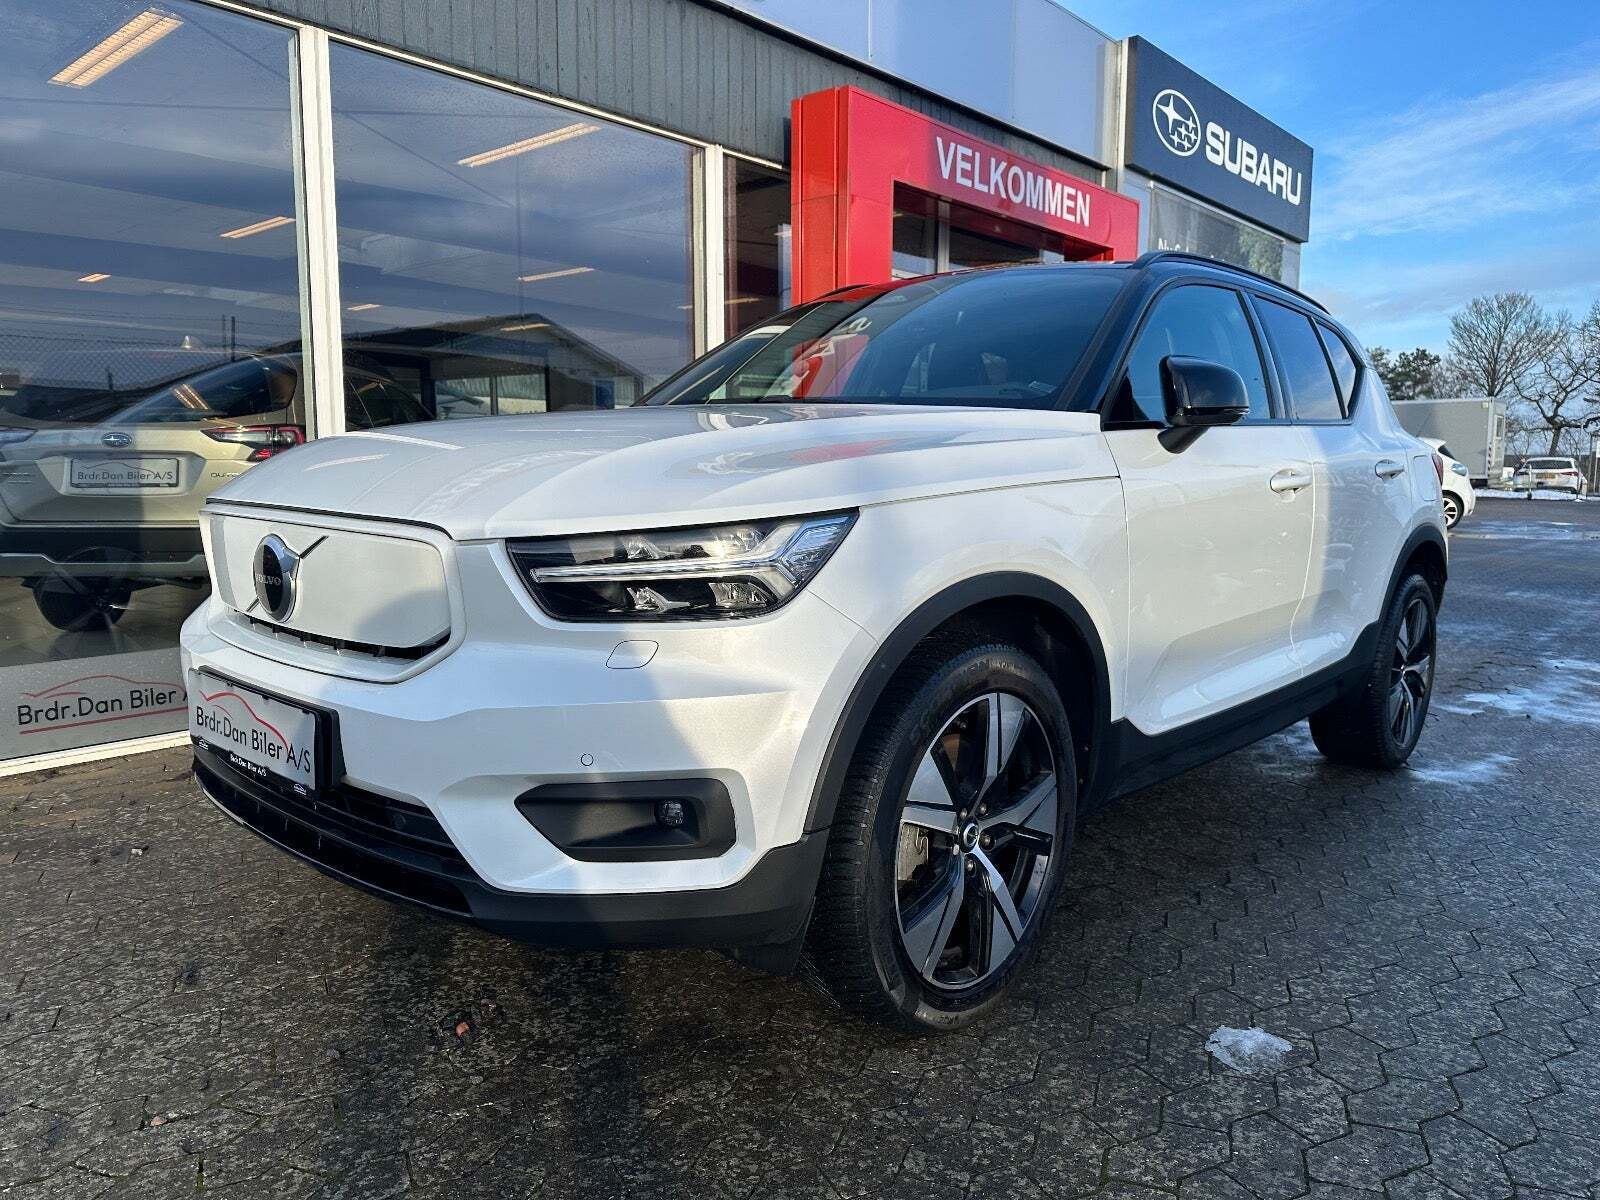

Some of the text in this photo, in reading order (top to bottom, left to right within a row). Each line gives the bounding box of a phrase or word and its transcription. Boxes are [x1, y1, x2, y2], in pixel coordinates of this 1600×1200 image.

[936, 136, 1091, 228] VELKOMMEN
[1205, 121, 1302, 206] SUBARU
[127, 471, 149, 480] Biler
[153, 471, 173, 481] A/S
[17, 696, 123, 726] Brdr.Dan
[130, 688, 177, 709] Biler
[196, 705, 311, 773] Brdr.Dan Biler A/S
